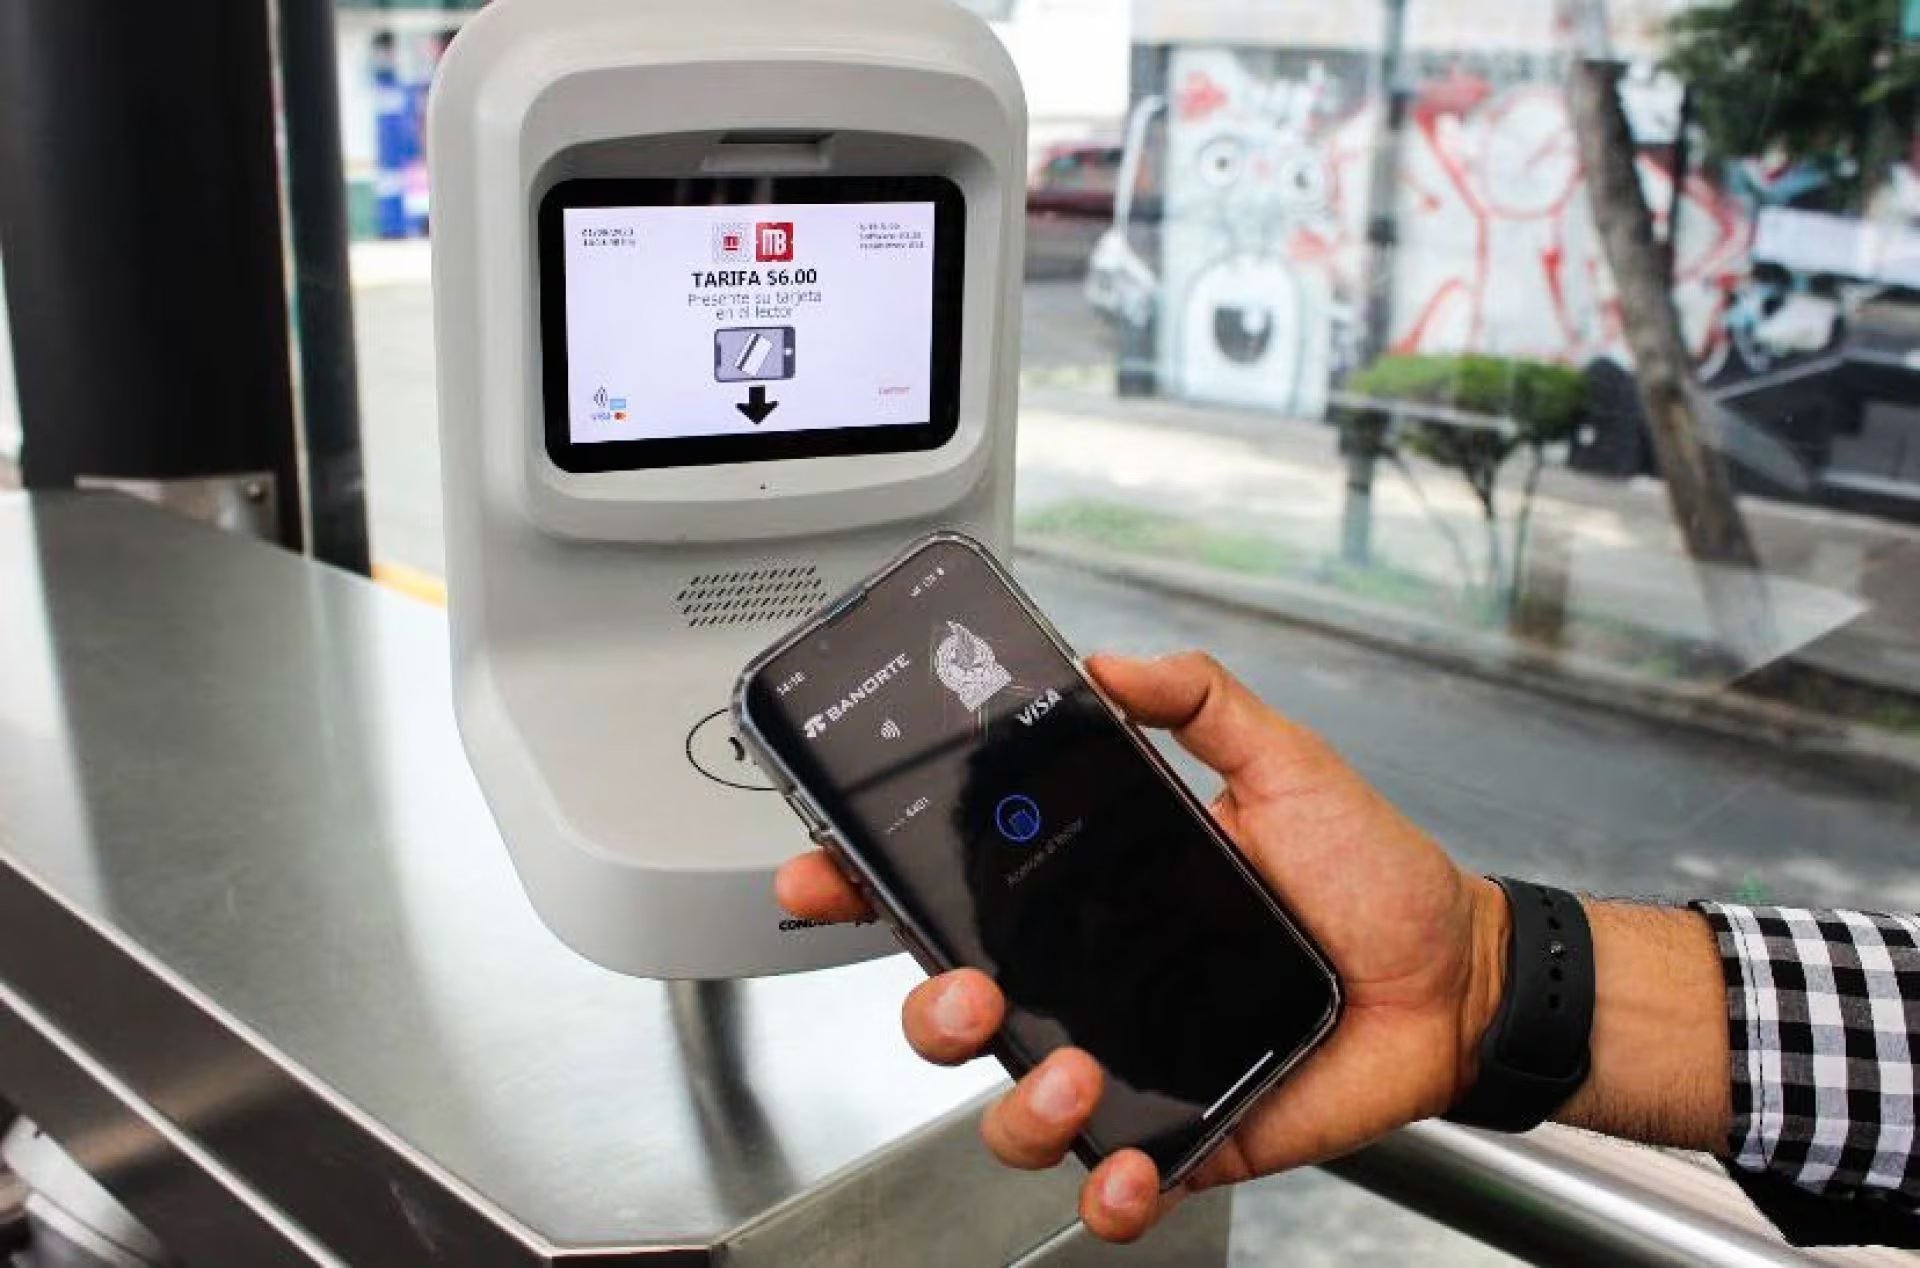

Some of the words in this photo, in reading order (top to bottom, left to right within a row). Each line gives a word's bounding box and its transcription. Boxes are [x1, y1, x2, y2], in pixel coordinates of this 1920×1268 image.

[690, 269, 761, 288] TARIFA
[688, 292, 750, 306] Presente
[755, 293, 771, 305] su
[775, 290, 821, 306] tarjeta
[716, 307, 734, 320] en
[739, 304, 750, 318] el
[755, 303, 791, 319] lector
[825, 653, 910, 721] BANORTE
[1015, 688, 1063, 726] VISA
